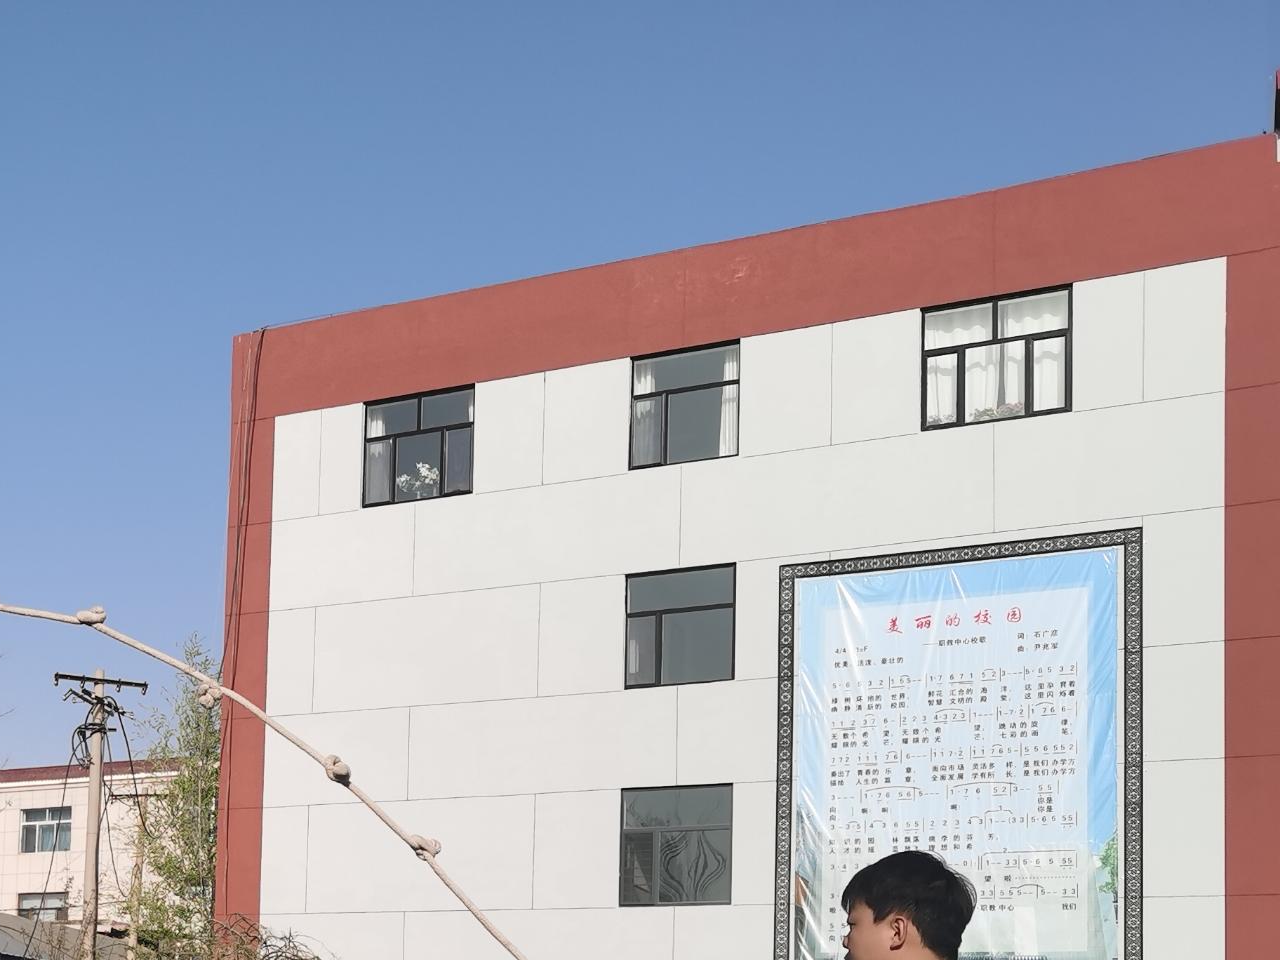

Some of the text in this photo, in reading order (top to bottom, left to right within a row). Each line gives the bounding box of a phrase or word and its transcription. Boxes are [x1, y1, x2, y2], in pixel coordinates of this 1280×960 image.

[885, 606, 1023, 635] 美丽的校园
